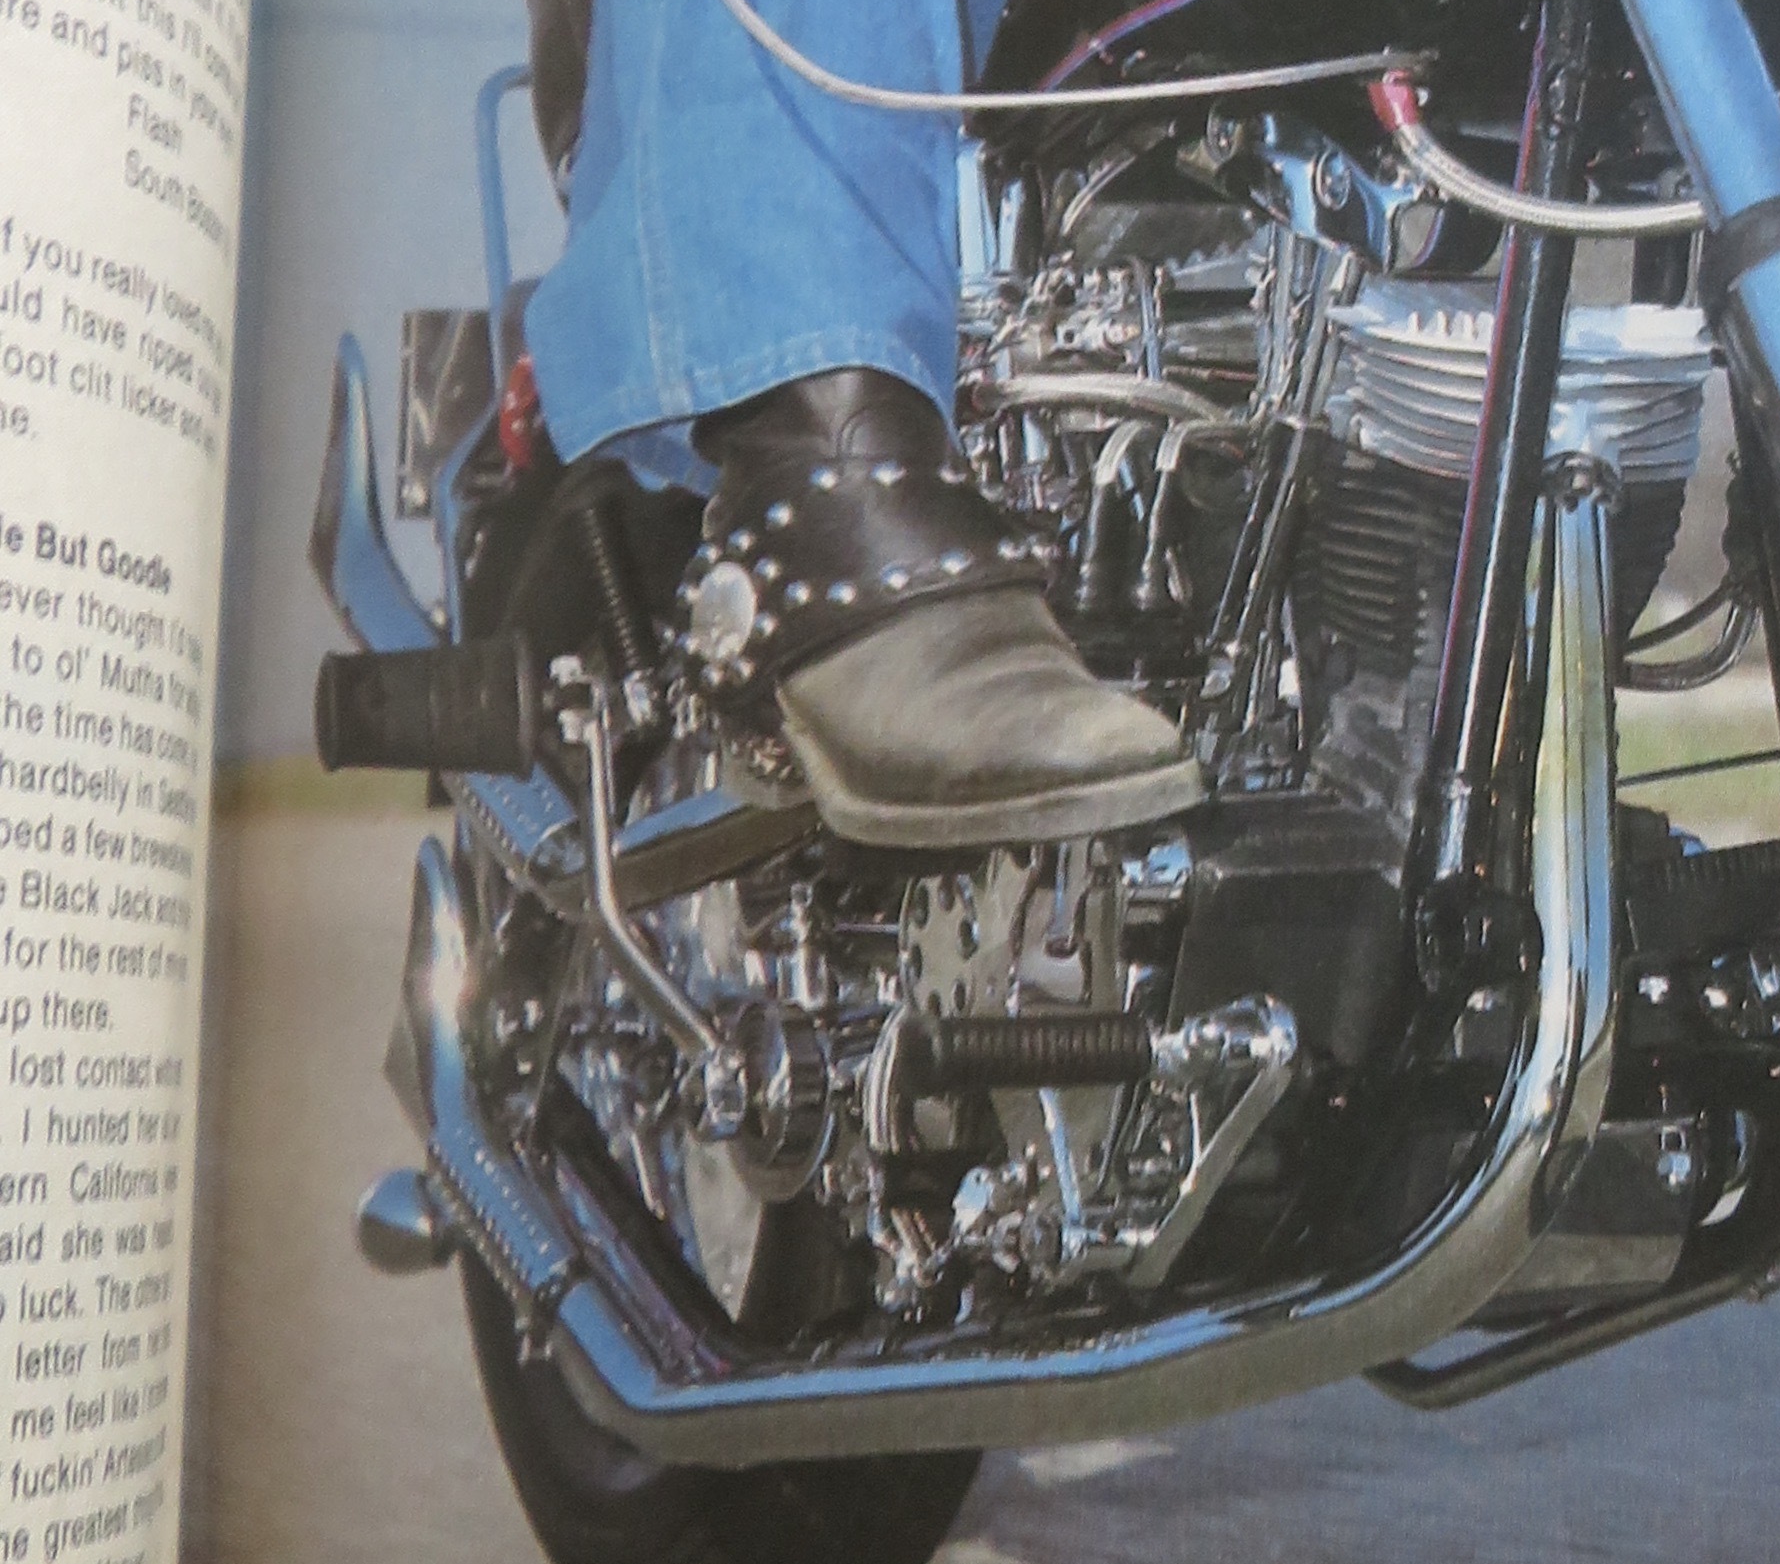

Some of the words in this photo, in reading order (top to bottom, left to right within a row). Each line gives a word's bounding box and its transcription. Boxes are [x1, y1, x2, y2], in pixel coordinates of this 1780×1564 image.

[50, 8, 108, 59] and
[23, 231, 82, 276] you
[62, 297, 128, 351] have
[34, 520, 89, 568] But
[11, 635, 43, 676] to
[56, 646, 91, 682] ol'
[54, 702, 114, 748] time
[19, 869, 99, 916] Black
[2, 927, 49, 969] for
[59, 934, 100, 975] the
[8, 1045, 66, 1088] lost
[61, 1221, 103, 1262] she
[18, 1282, 84, 1323] luck.
[14, 1342, 87, 1381] letter
[10, 1406, 54, 1442] me
[10, 1449, 99, 1499] fuckin'
